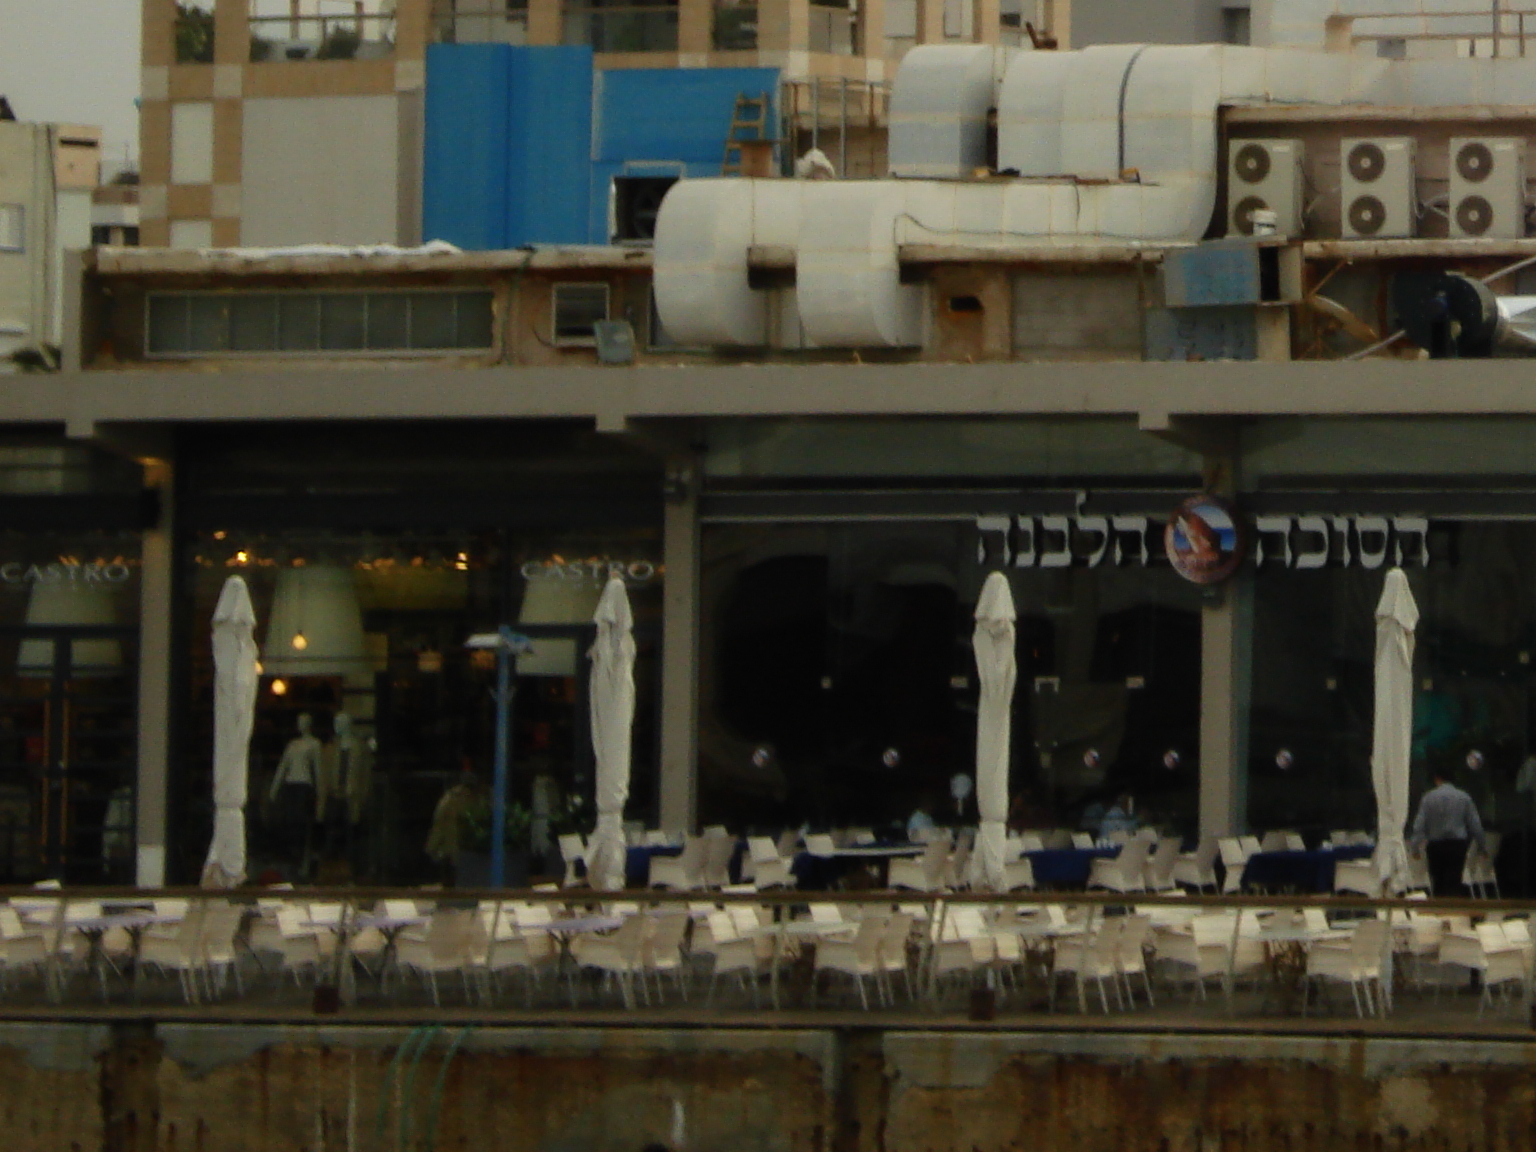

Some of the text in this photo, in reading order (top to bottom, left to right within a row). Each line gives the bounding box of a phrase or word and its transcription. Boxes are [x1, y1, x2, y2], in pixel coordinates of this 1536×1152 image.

[976, 490, 1429, 569] הסוכה הלבנה
[0, 561, 130, 583] CASTRO
[520, 560, 655, 581] CASTRO
